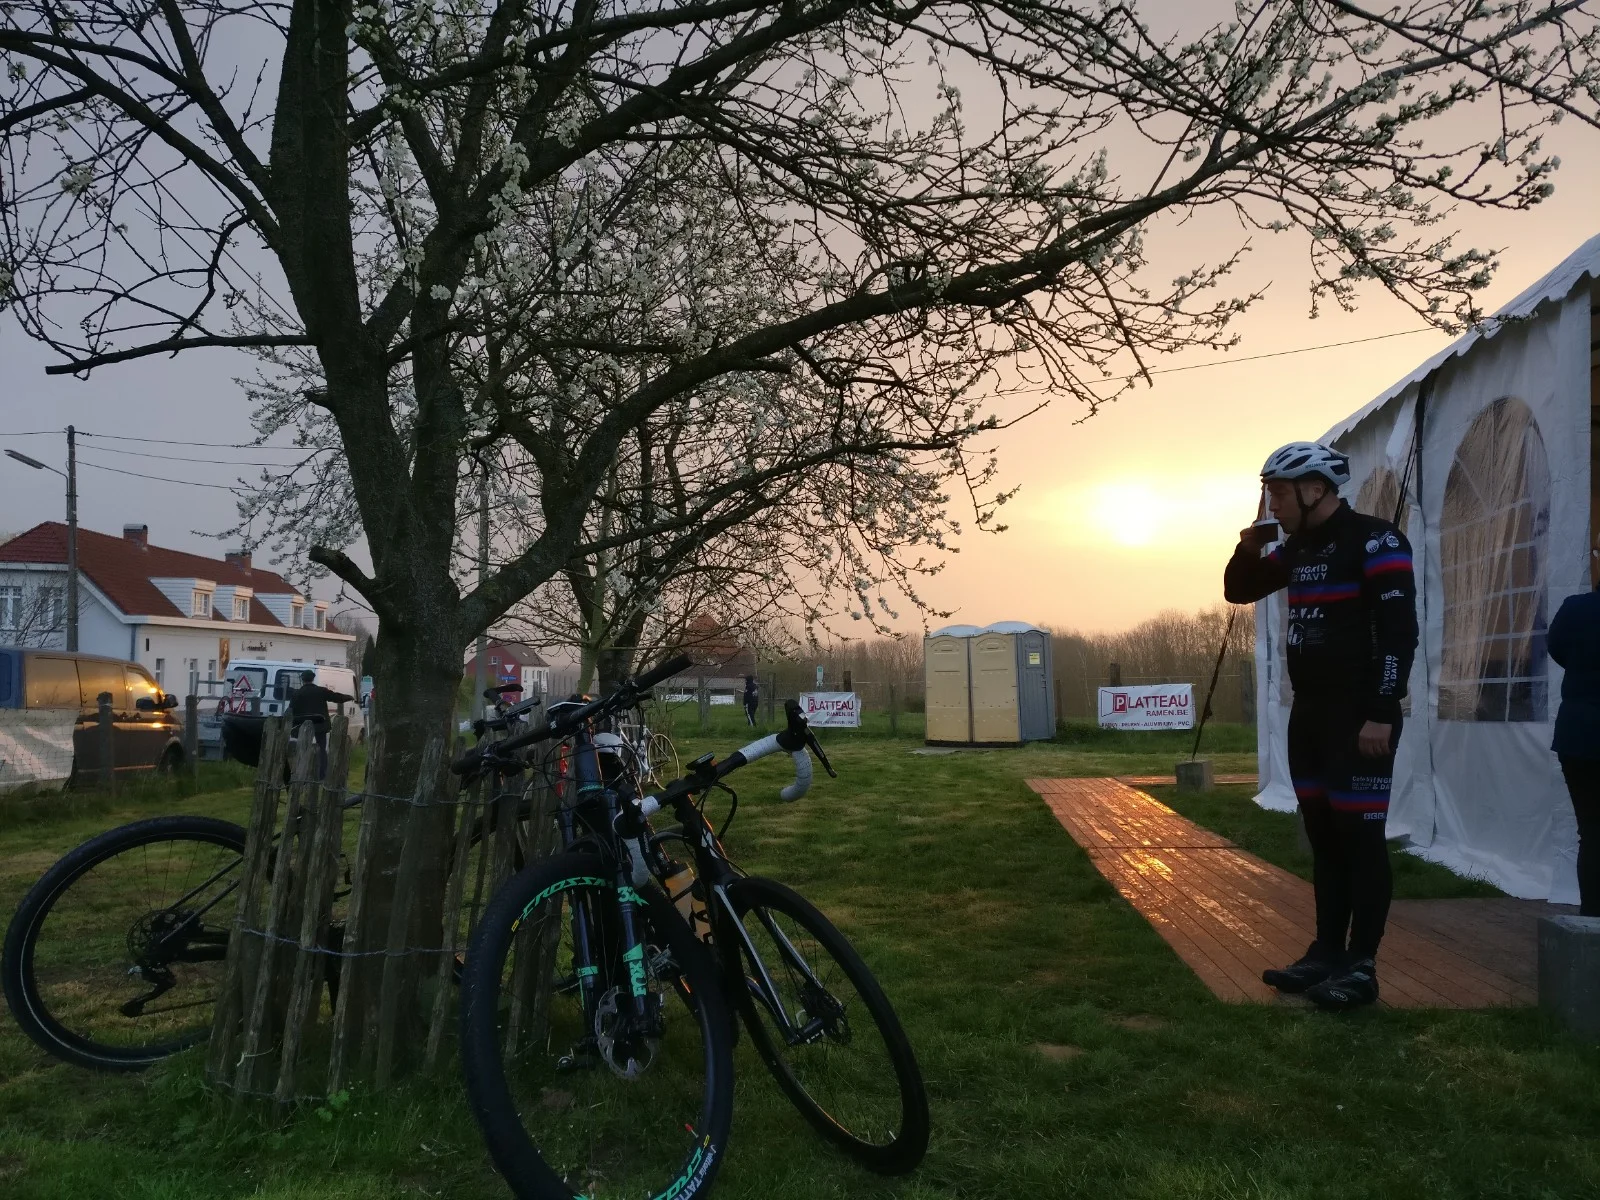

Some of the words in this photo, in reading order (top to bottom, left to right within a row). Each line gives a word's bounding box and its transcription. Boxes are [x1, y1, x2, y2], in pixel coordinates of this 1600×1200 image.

[1300, 573, 1327, 581] DAVY
[1390, 656, 1399, 680] DAVY
[808, 698, 853, 712] PLATTEAU
[1116, 694, 1188, 711] PLATTEAU
[1146, 709, 1188, 717] RAMEN.BE
[629, 960, 648, 997] FOX
